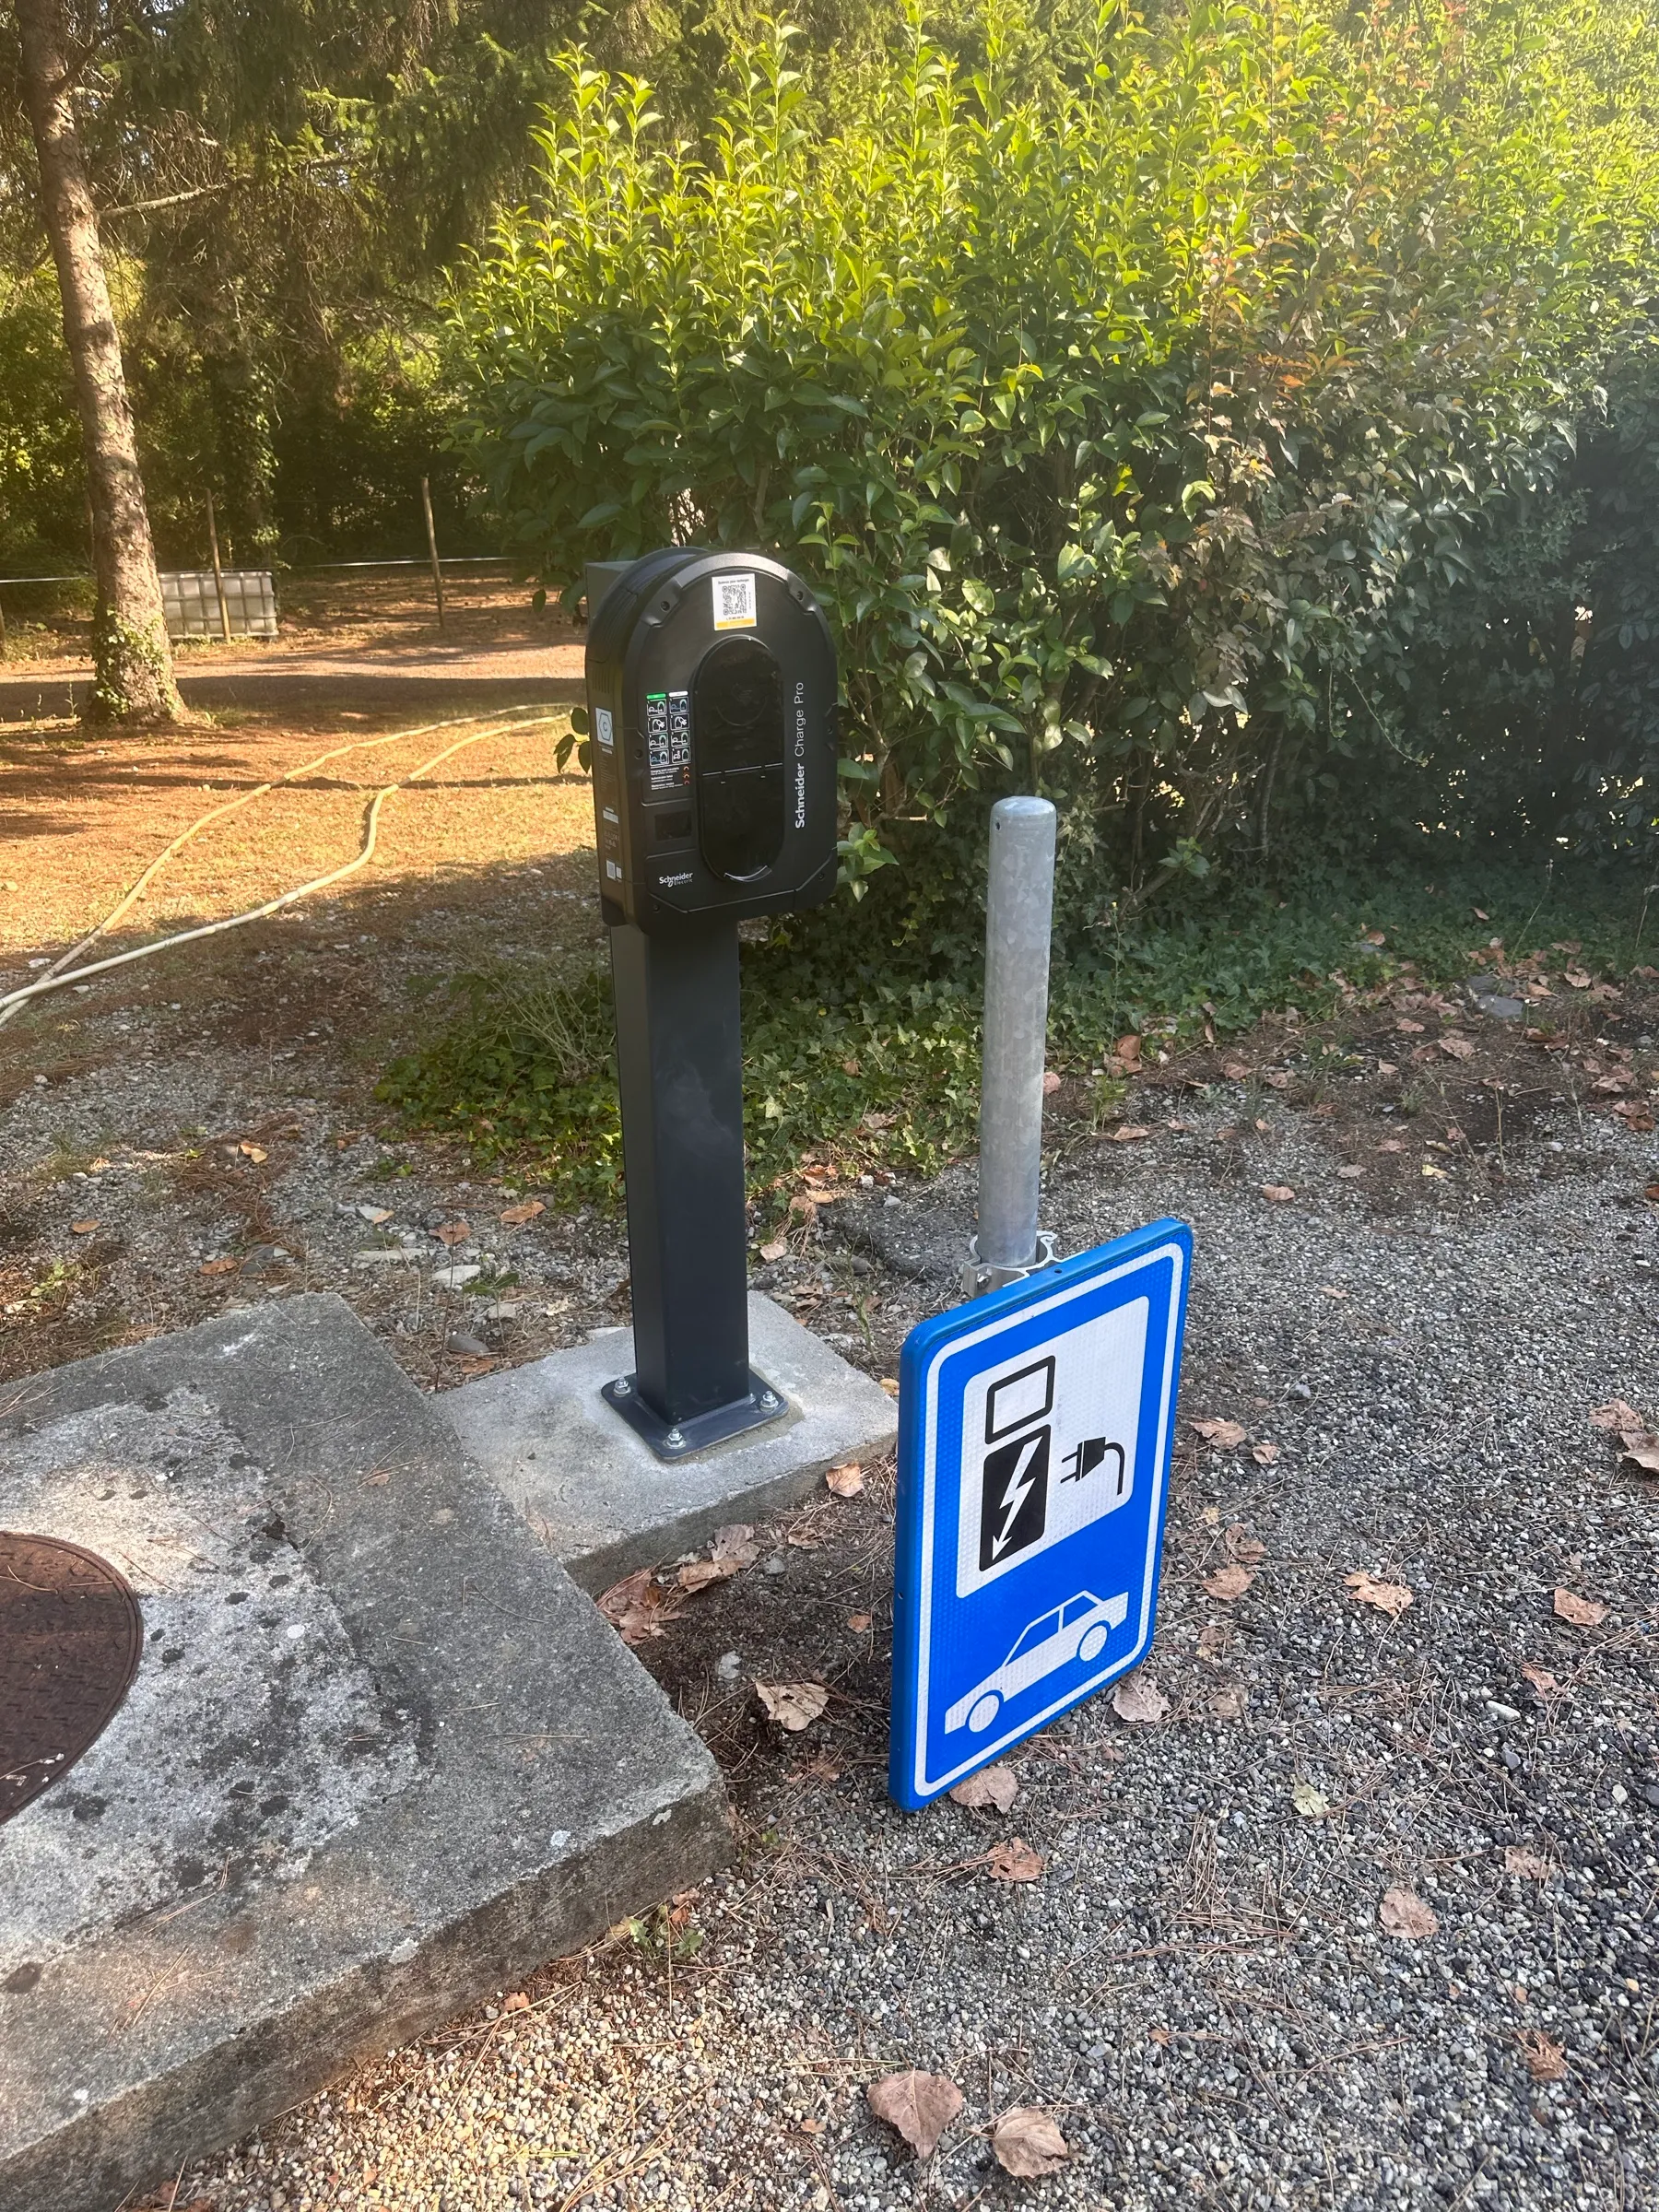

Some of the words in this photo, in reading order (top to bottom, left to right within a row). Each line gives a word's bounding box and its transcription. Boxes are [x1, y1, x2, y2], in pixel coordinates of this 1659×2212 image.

[794, 682, 804, 704] Pro
[794, 709, 806, 757] Charge
[794, 763, 805, 829] Schneider
[659, 872, 693, 885] Schneider
